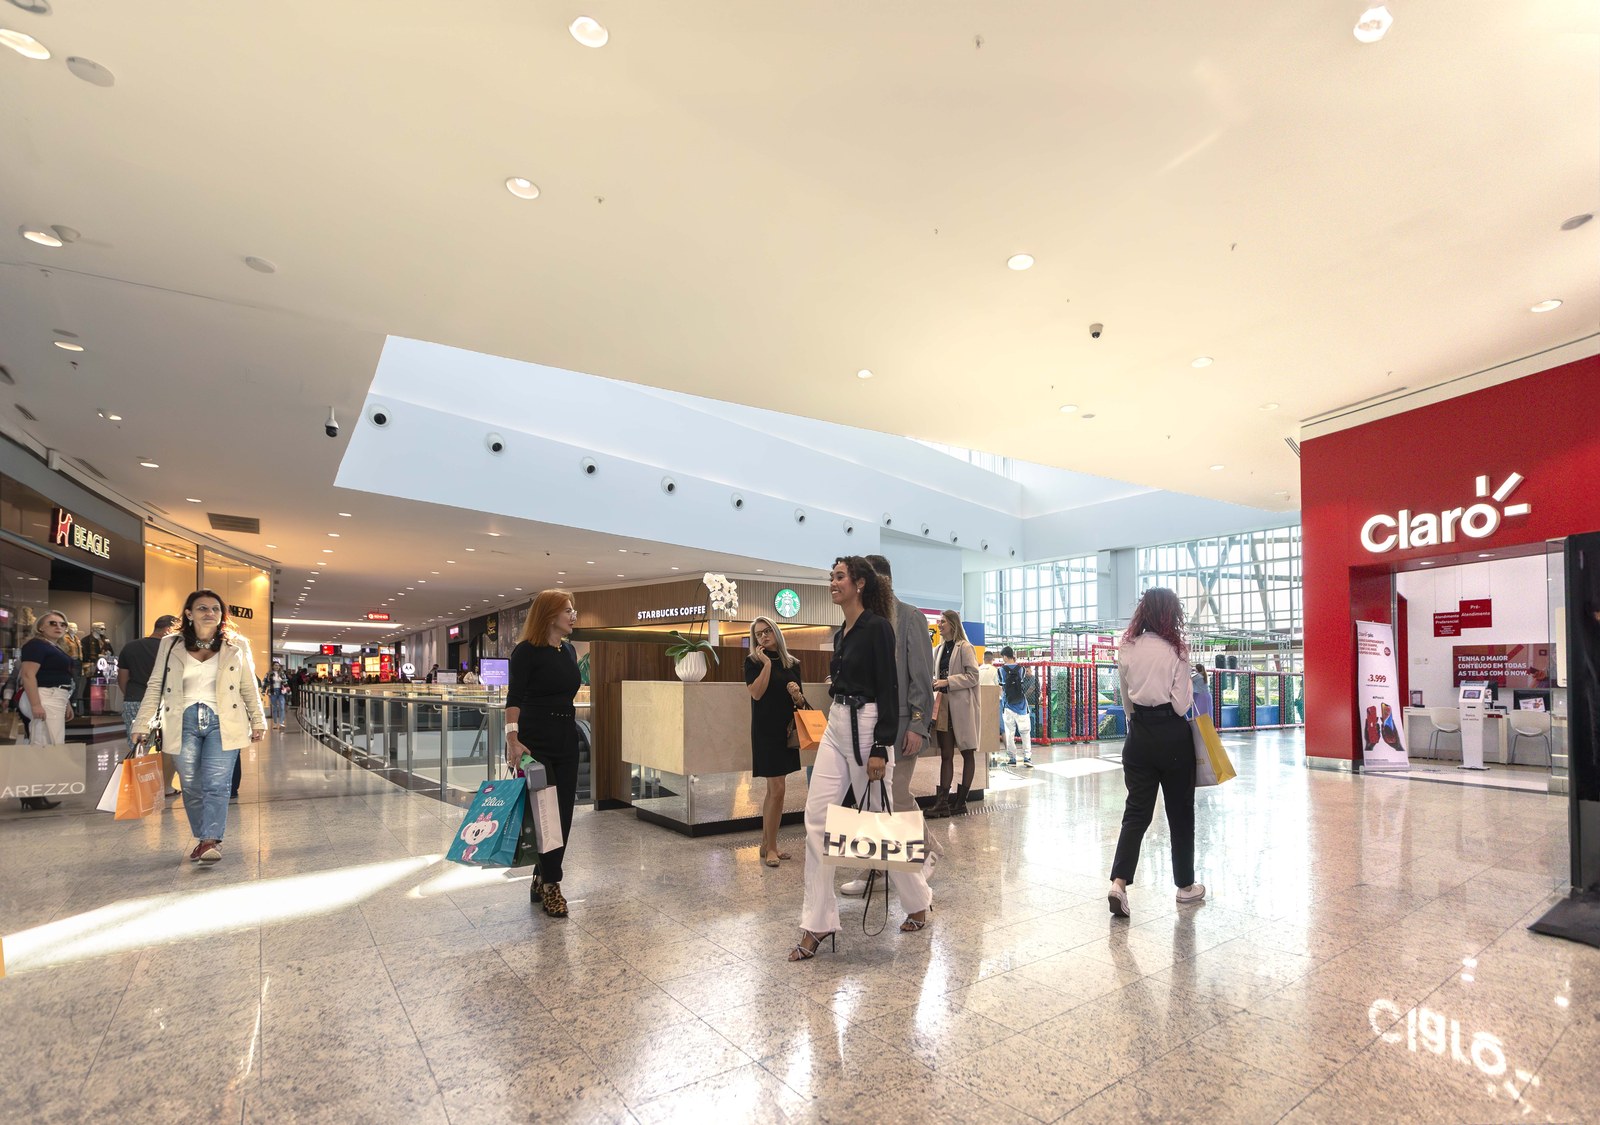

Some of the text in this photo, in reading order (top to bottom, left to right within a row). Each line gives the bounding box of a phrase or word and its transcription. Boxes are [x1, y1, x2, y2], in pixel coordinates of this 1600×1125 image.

[74, 523, 110, 559] BEAGLE
[1361, 503, 1501, 553] Claro
[637, 605, 706, 620] STARBUCKS COFFEE
[0, 782, 85, 798] AREZZO
[823, 831, 925, 863] HOPE
